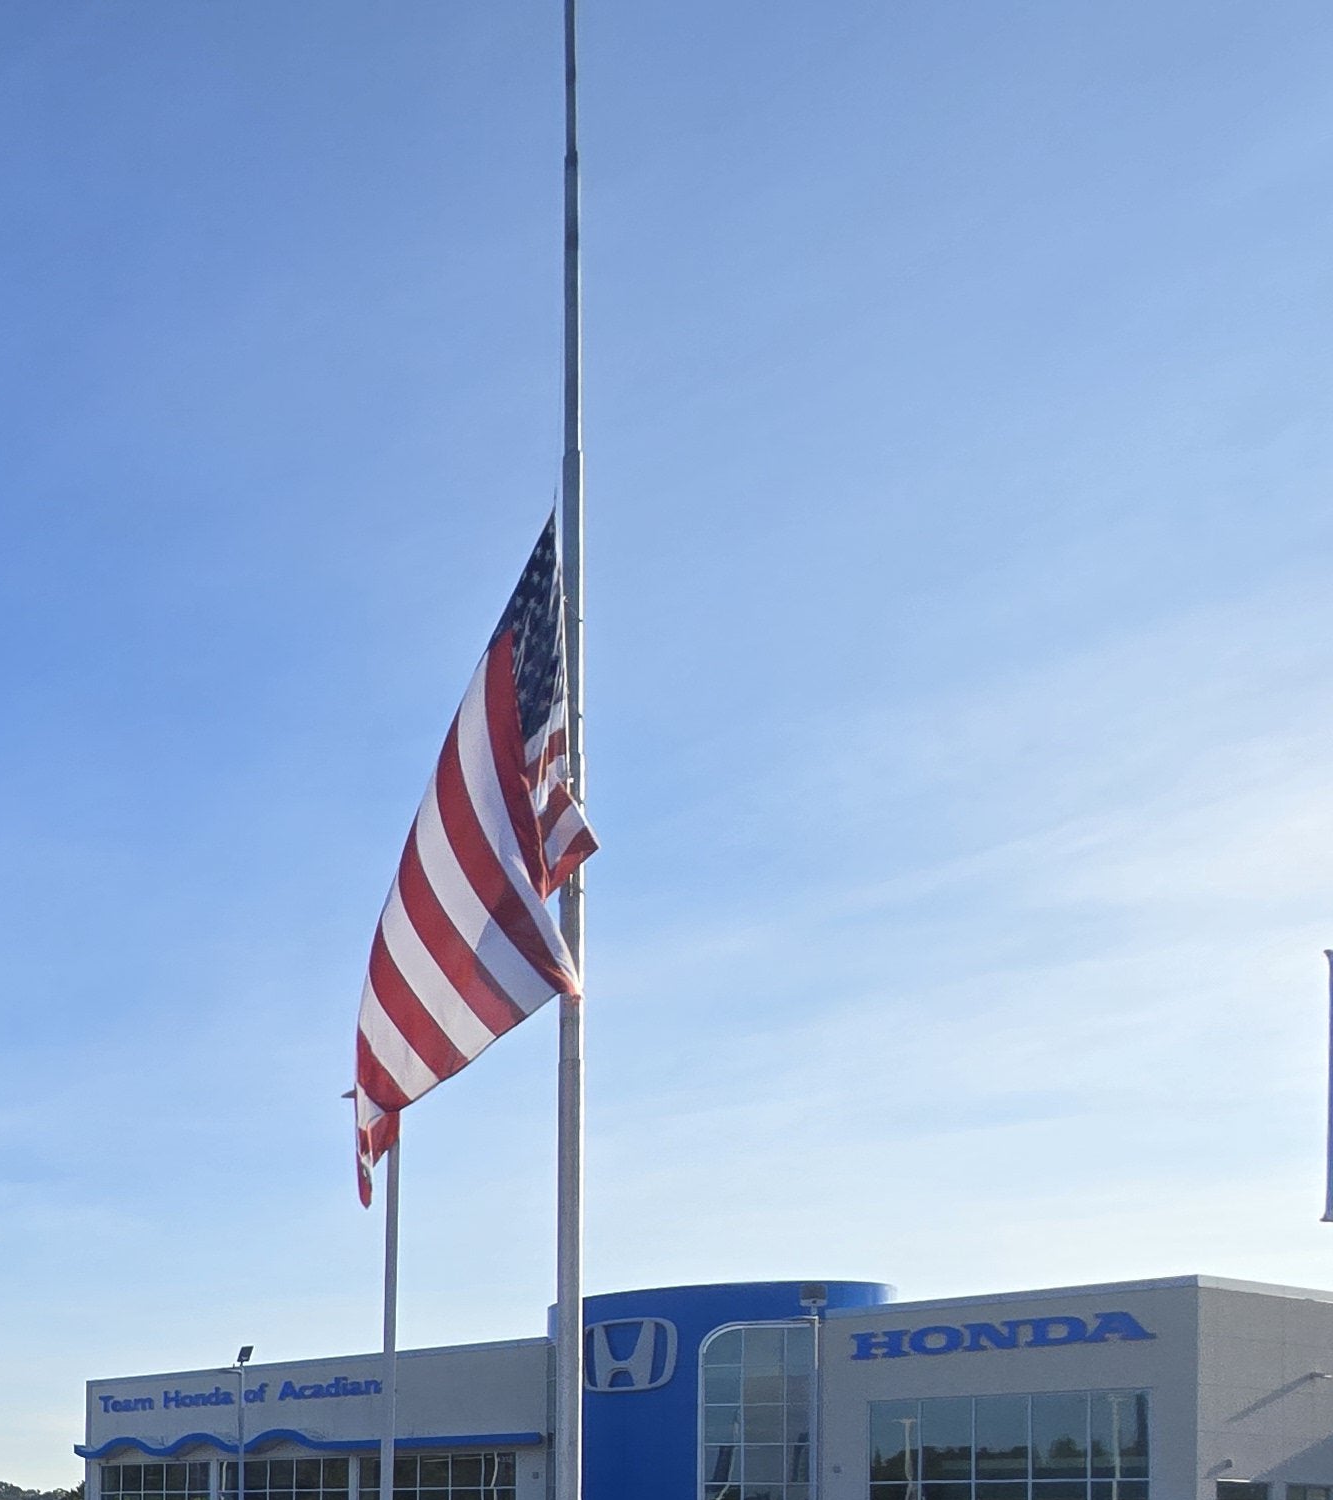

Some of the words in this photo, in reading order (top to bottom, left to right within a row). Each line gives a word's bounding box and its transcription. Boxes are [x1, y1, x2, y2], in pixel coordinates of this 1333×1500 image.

[850, 1311, 1157, 1361] HONDA
[98, 1394, 155, 1414] Team
[163, 1386, 235, 1410] Honda
[243, 1382, 270, 1404] of
[277, 1375, 383, 1401] Acadian
